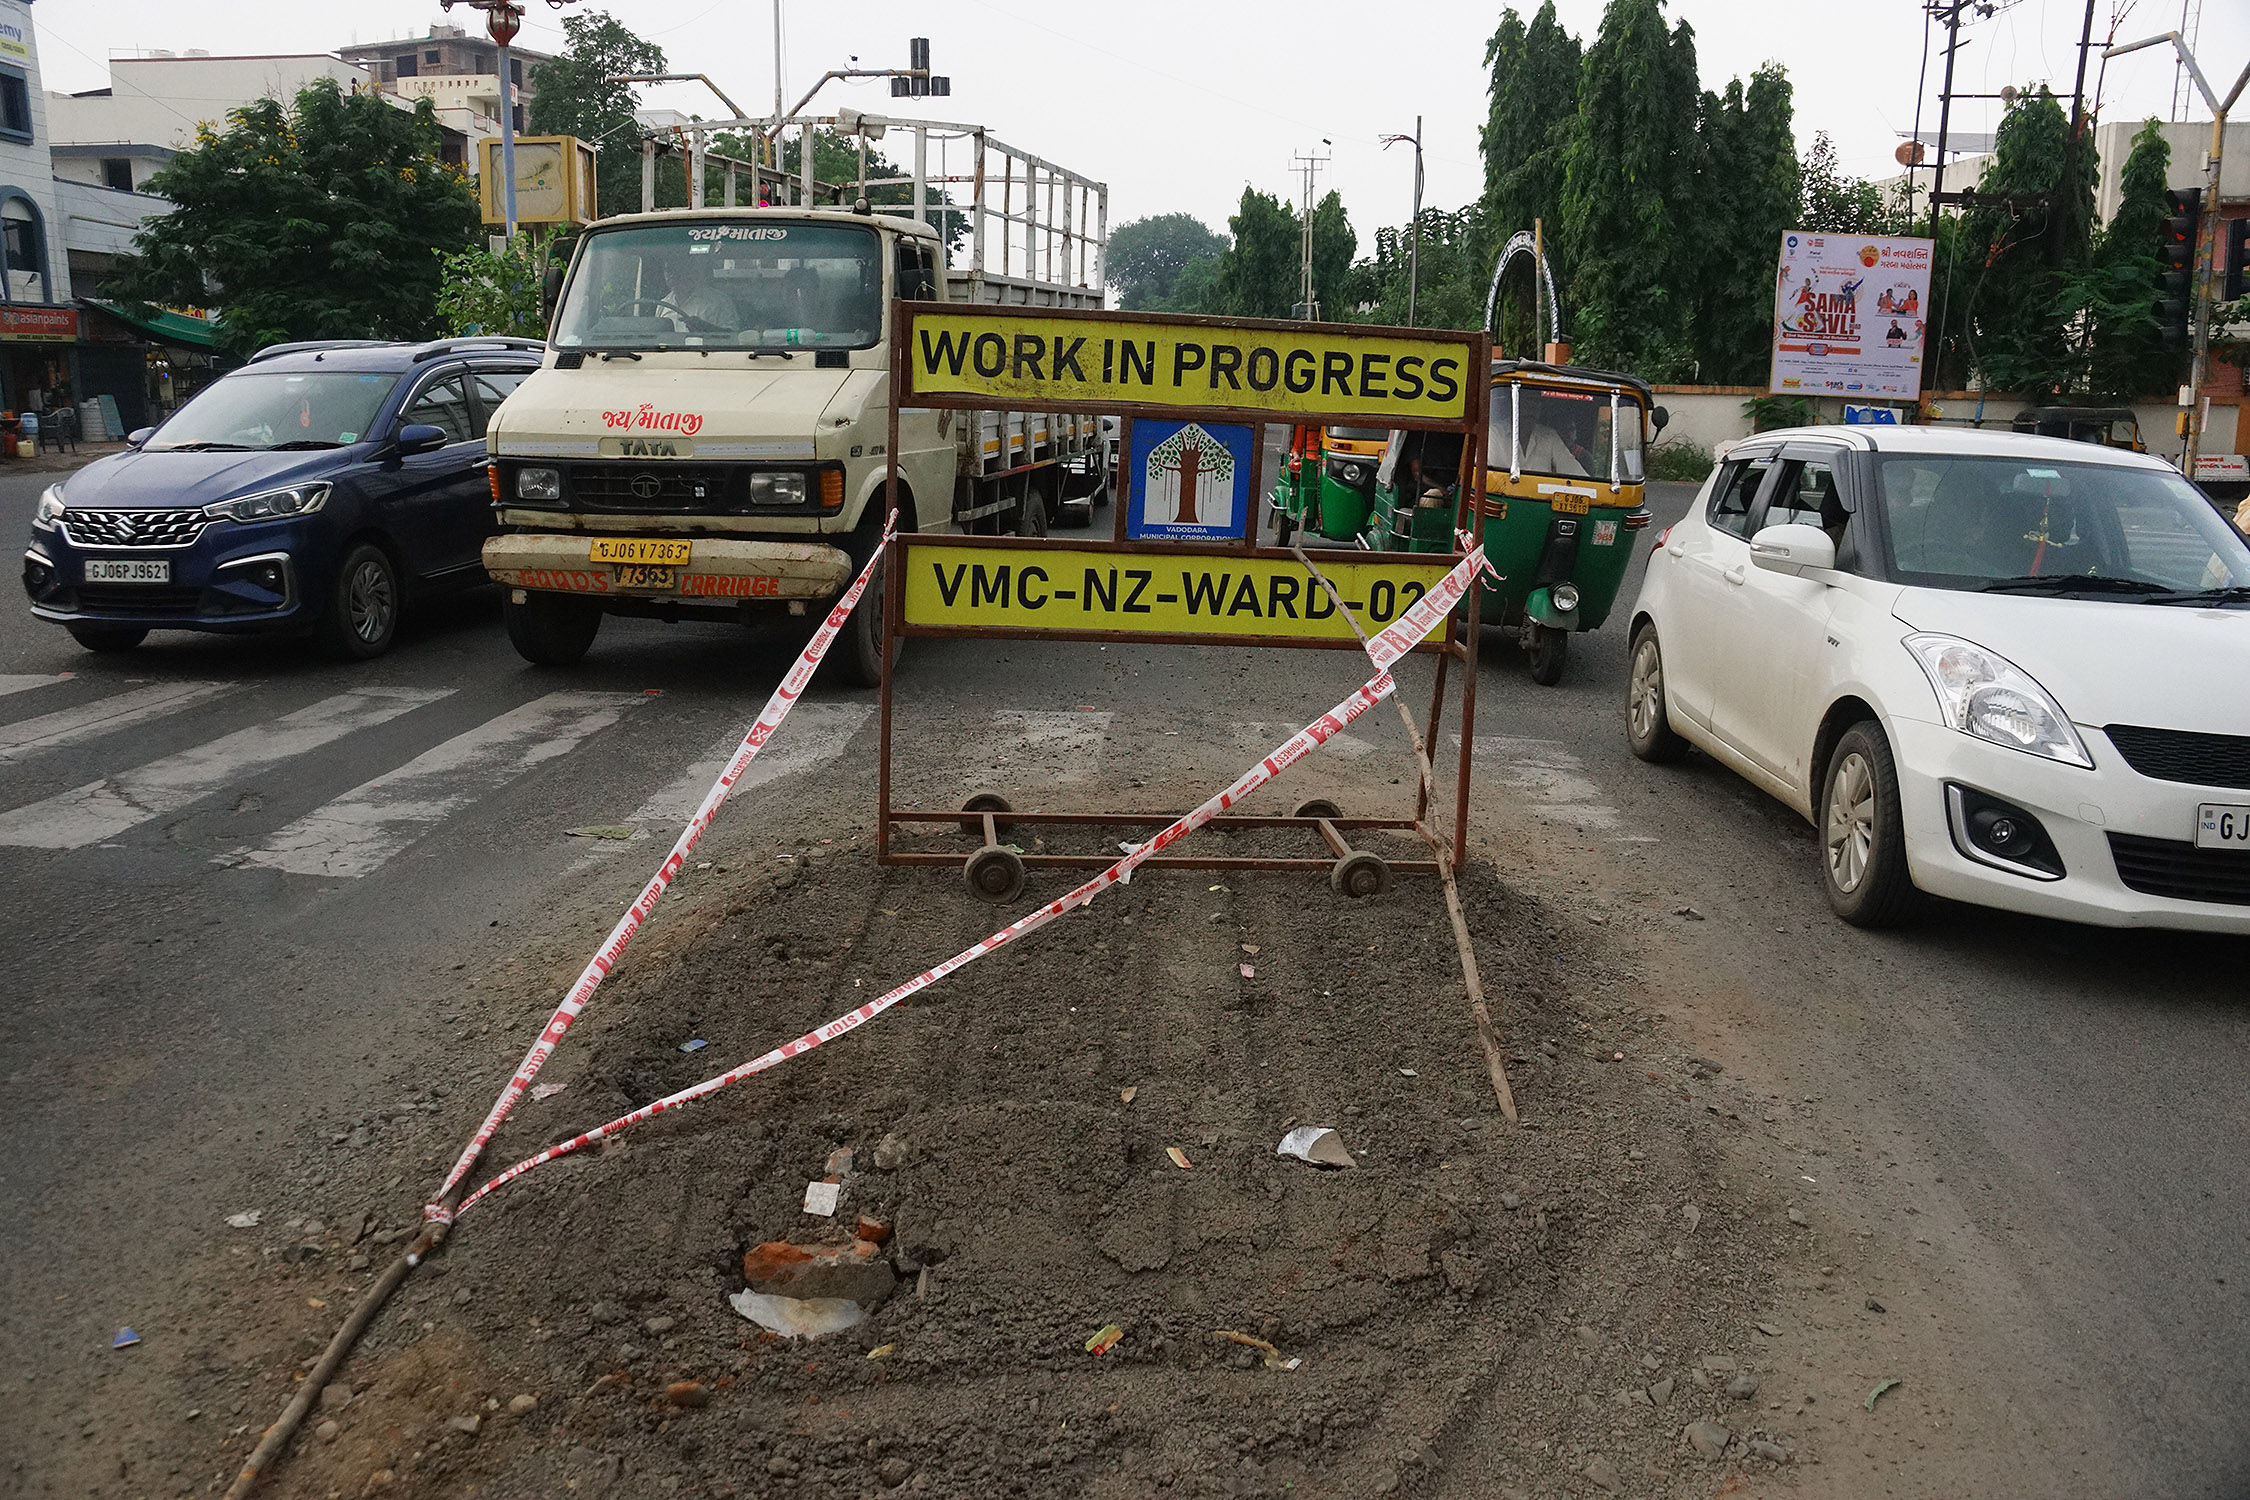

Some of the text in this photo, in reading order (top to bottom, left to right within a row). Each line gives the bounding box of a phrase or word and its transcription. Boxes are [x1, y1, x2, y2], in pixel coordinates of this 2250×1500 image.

[1804, 292, 1856, 314] SAMA
[919, 329, 1460, 402] WORK IN PROGRESS
[601, 411, 632, 428] જય
[620, 439, 677, 456] TATA
[649, 544, 683, 559] 7363
[92, 564, 168, 579] GJ06PJ9621
[681, 575, 779, 596] CARRIAGE
[933, 563, 1426, 622] VMC-NZ-WARD-02
[1345, 701, 1368, 723] STOP
[1274, 738, 1307, 765] PROGRESS
[2201, 822, 2215, 830] IND
[2220, 812, 2250, 841] GJ
[641, 882, 662, 912] STOP
[607, 922, 637, 963] DANGER
[951, 951, 975, 968] WORK
[572, 973, 600, 1006] WORK IN
[826, 1015, 858, 1038] STOP
[523, 1047, 549, 1076] STOP
